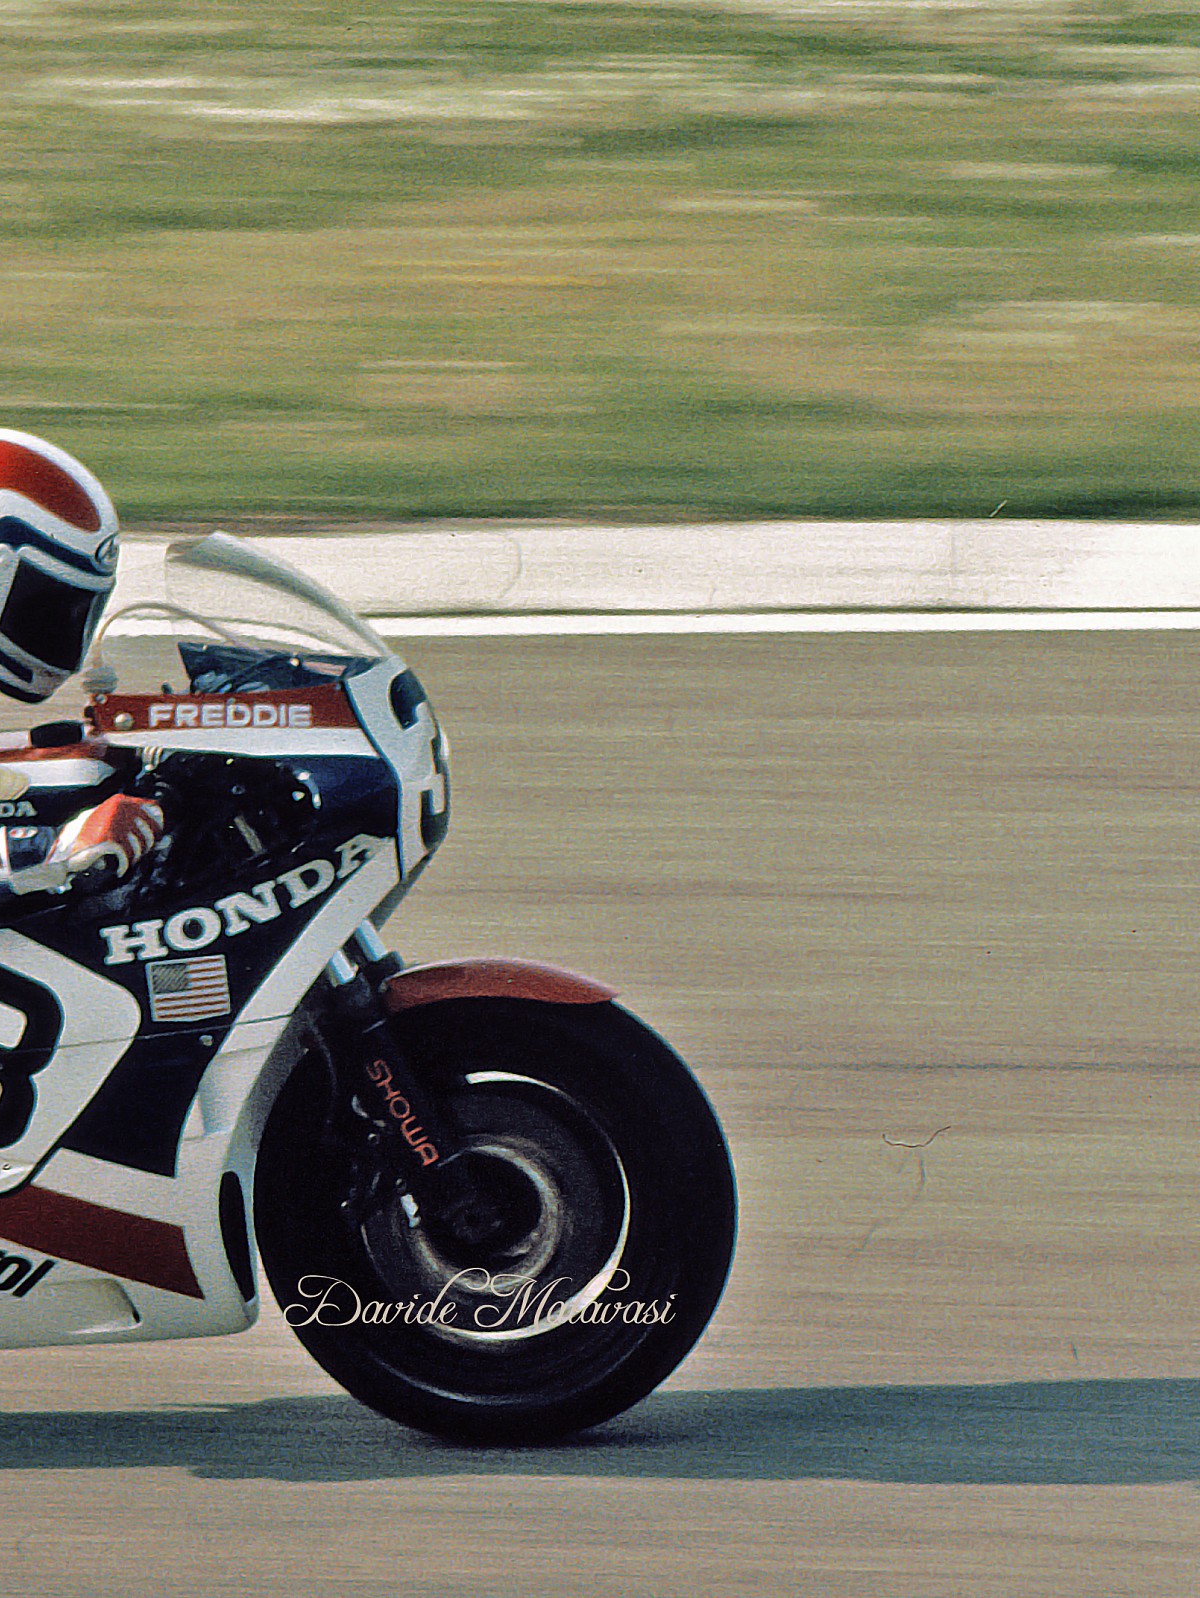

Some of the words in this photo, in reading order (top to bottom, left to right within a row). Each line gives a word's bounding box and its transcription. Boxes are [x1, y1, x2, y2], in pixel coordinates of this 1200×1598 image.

[148, 702, 313, 728] FREDDIE
[99, 833, 396, 962] HONDA
[366, 1059, 439, 1167] SHOWA
